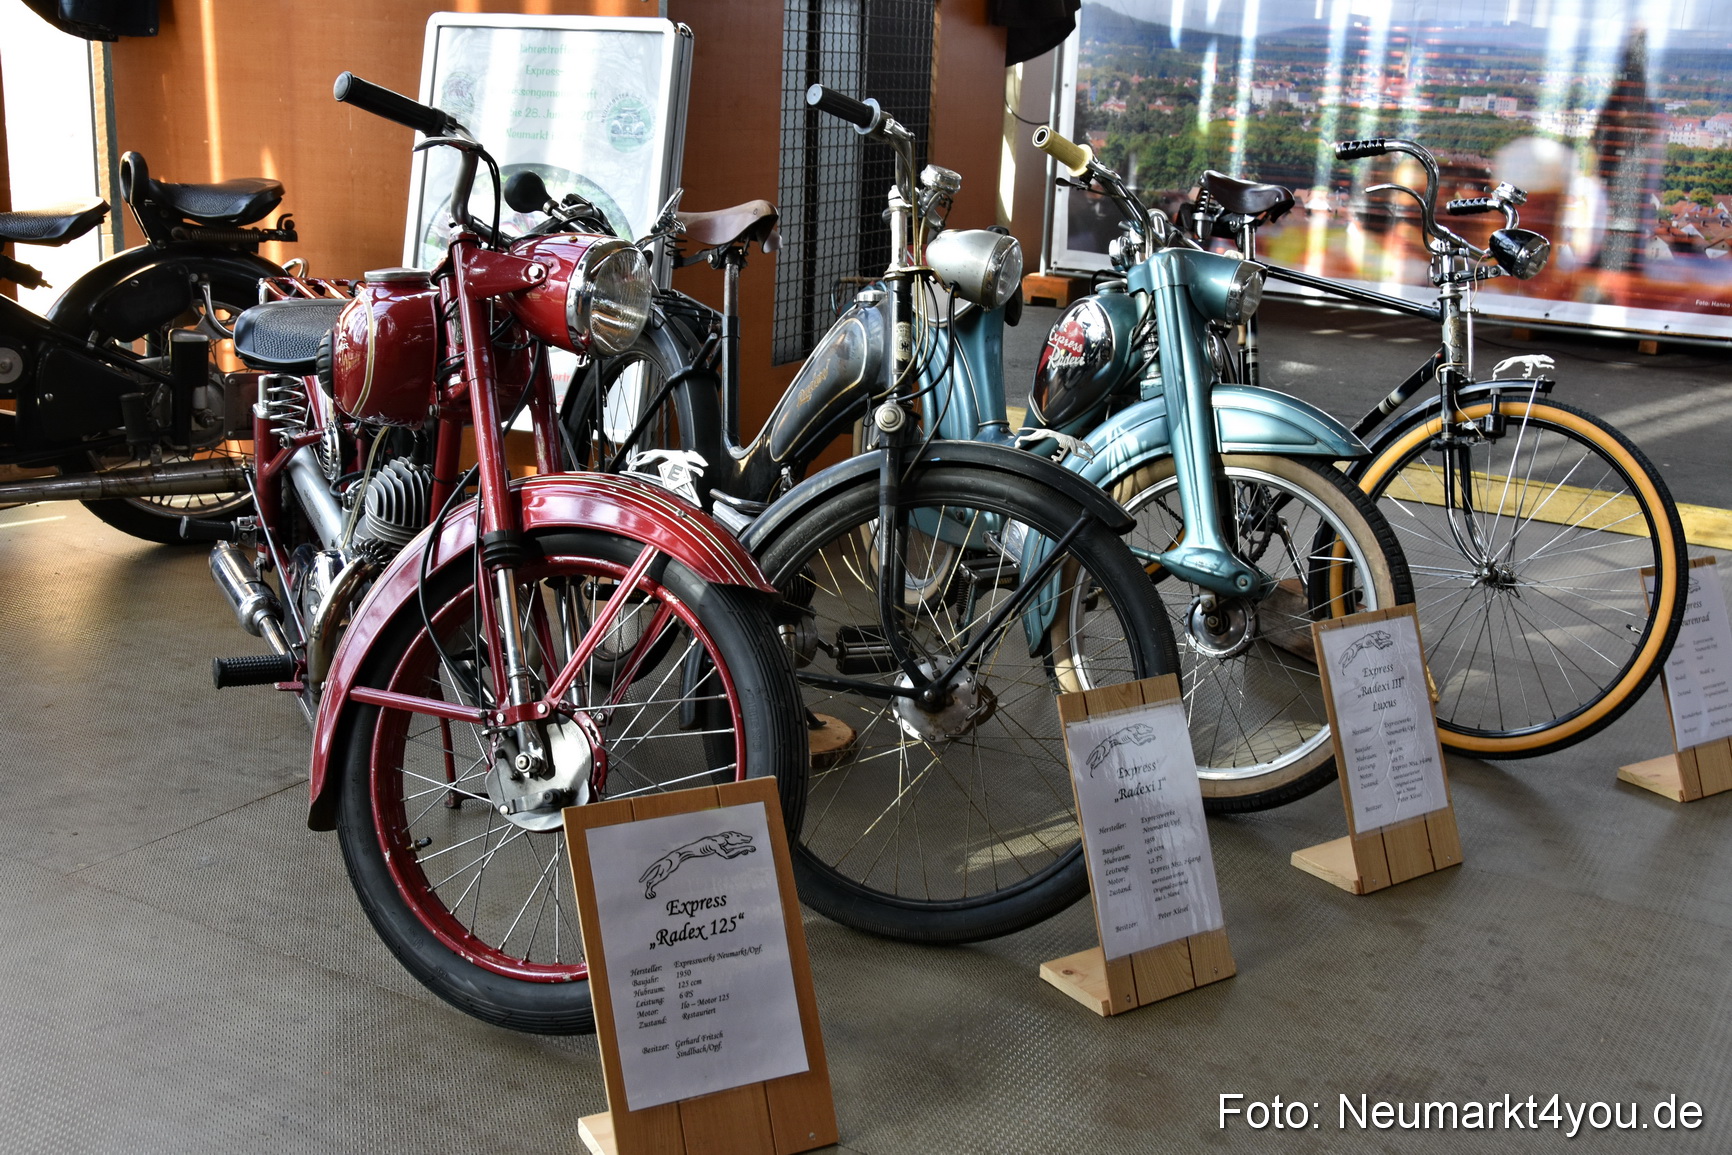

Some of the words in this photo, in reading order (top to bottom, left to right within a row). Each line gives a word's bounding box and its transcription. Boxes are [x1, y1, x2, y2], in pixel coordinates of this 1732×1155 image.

[1362, 663, 1394, 679] Express
[1373, 699, 1396, 711] Luxus
[1117, 762, 1156, 780] Express
[1114, 782, 1154, 803] „Radexi
[1099, 823, 1126, 834] Hersteller:
[1102, 844, 1124, 855] Baujahr:
[1104, 854, 1130, 865] Hubraum:
[1105, 865, 1129, 876] Leistung:
[1108, 877, 1125, 885] Motor:
[666, 895, 726, 917] Express
[650, 922, 708, 950] „Radex
[710, 912, 744, 935] 125“
[1115, 922, 1137, 933] Besitzer:
[630, 964, 662, 976] Hersteller:
[674, 954, 715, 968] Expresswerke
[717, 944, 762, 960] Neumarkt/Opf.
[632, 975, 659, 987] Baujahr:
[676, 969, 692, 978] 1950
[634, 987, 665, 997] Hubraum:
[678, 980, 689, 989] 125
[636, 998, 664, 1008] Leistung:
[684, 990, 694, 998] PS
[637, 1009, 658, 1018] Motor:
[697, 997, 717, 1006] Motor
[719, 993, 729, 1002] 125
[639, 1016, 666, 1029] Zustand:
[682, 1008, 716, 1020] Restauriert
[642, 1044, 669, 1054] Besitzer:
[675, 1035, 700, 1049] Gerhard
[701, 1030, 723, 1042] Fritsch
